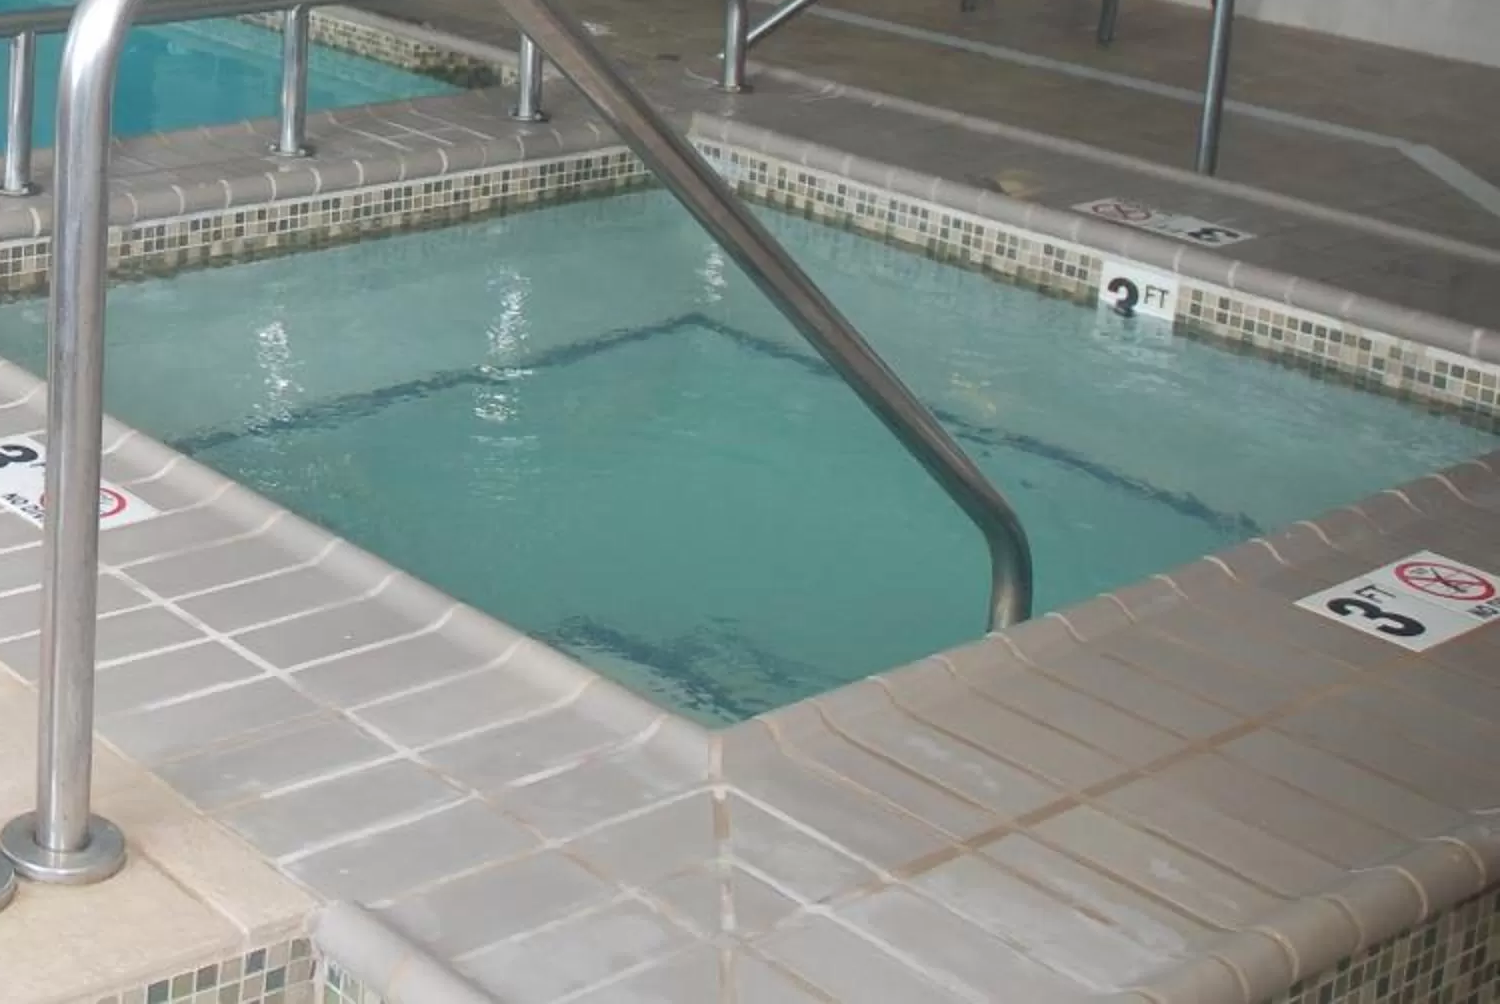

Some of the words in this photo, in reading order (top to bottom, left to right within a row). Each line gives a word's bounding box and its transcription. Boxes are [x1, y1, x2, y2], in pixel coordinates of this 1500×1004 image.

[1144, 284, 1170, 308] FT
[1353, 584, 1396, 604] FT
[1326, 597, 1426, 637] 3
